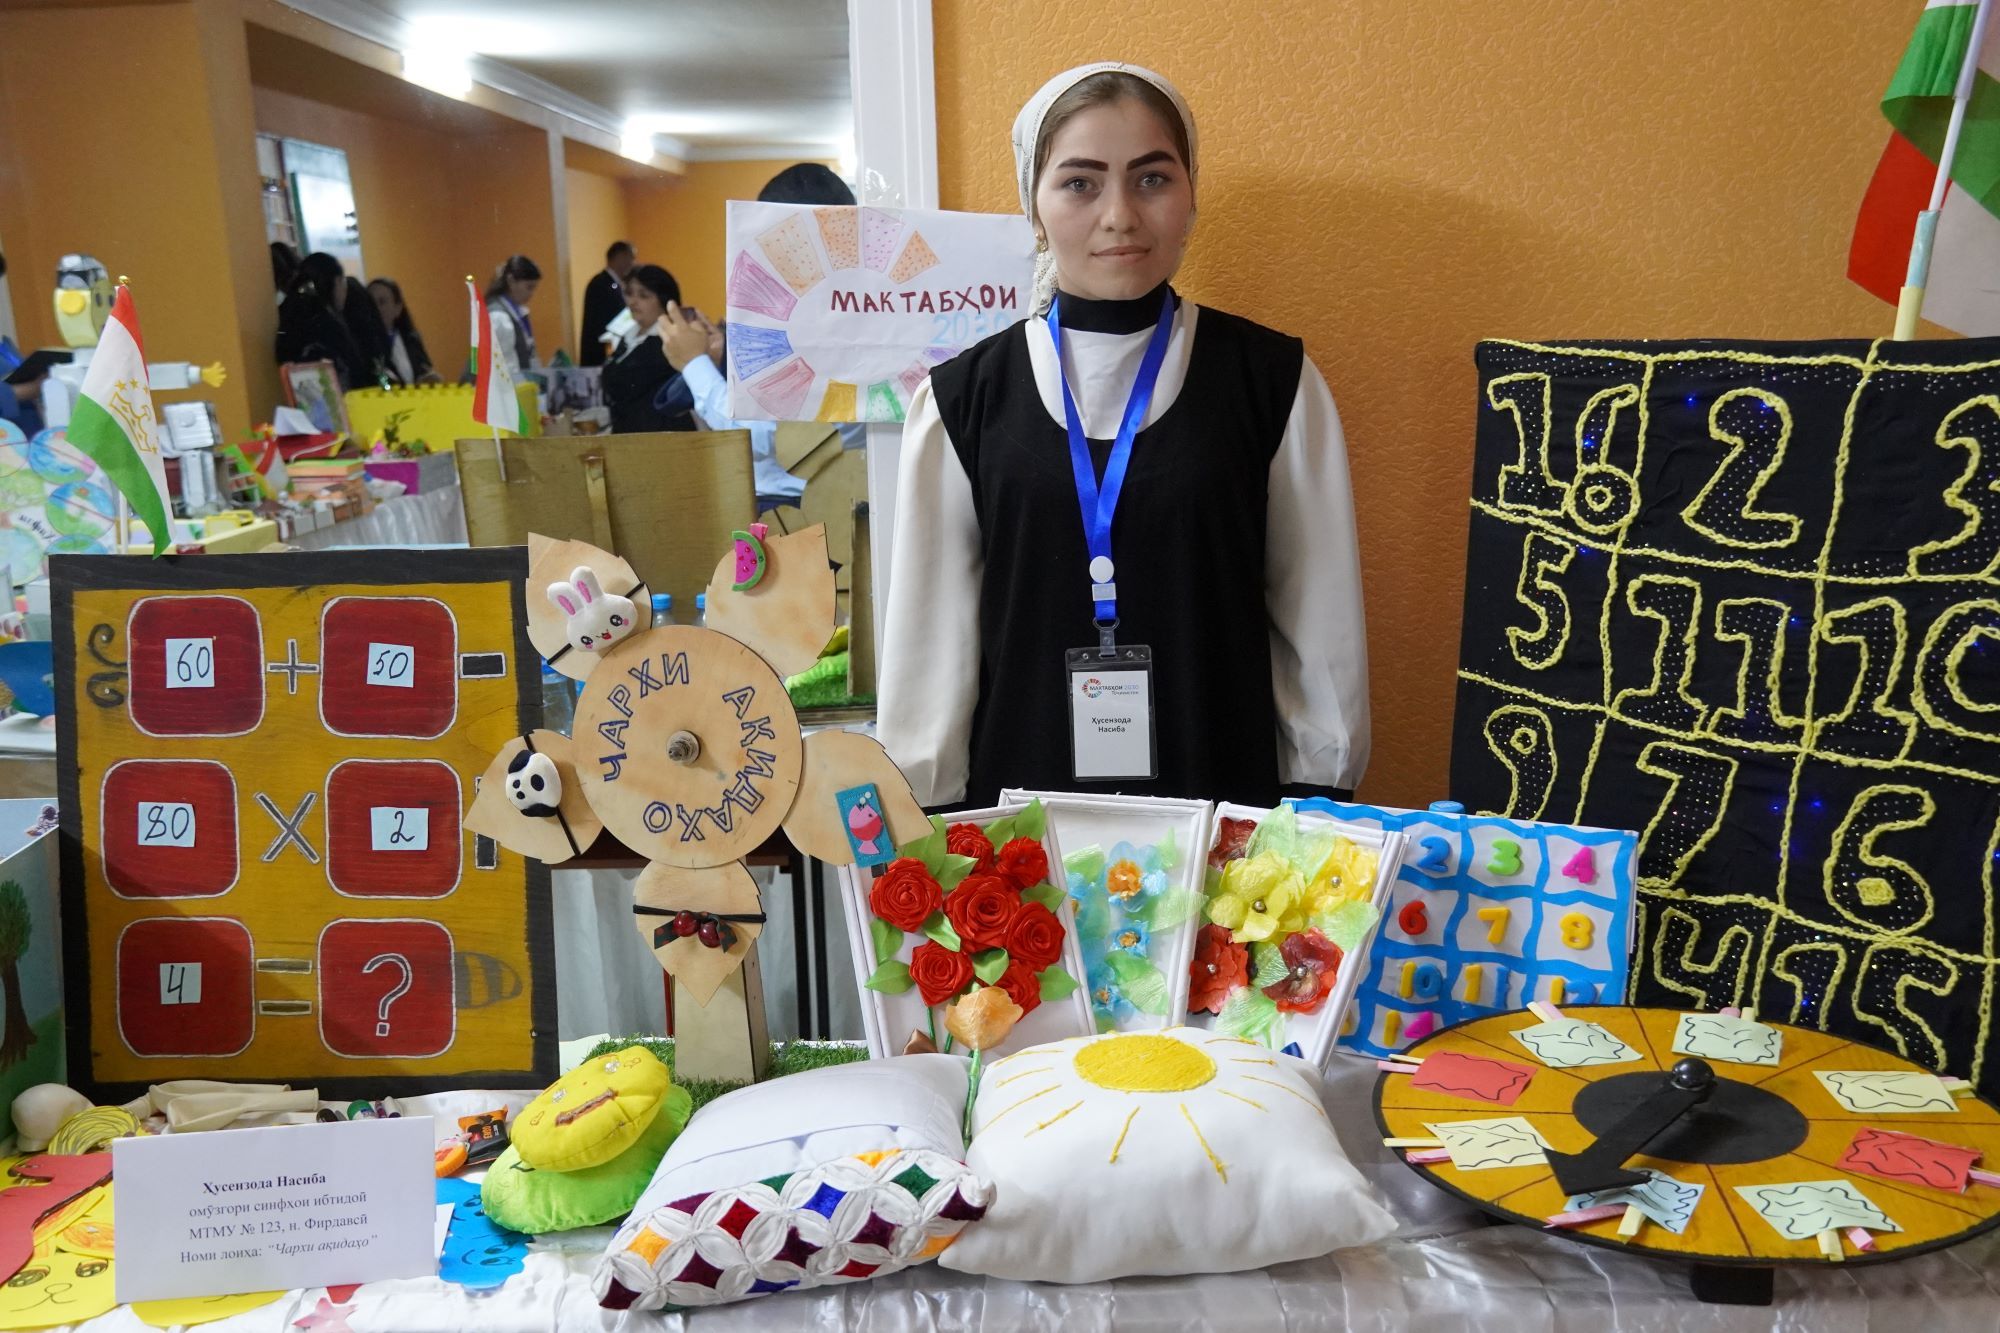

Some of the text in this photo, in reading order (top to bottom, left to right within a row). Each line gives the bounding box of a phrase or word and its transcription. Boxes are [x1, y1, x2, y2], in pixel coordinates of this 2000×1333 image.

[1680, 386, 1803, 550] 2
[1505, 531, 1577, 671] 5
[177, 643, 211, 681] 60
[373, 648, 408, 679] 50
[598, 651, 689, 782] ЧАРХИ
[147, 805, 190, 839] 80
[390, 810, 416, 843] 2
[1635, 741, 1739, 888] 7
[1824, 784, 1937, 936] 6
[1417, 836, 1597, 884] 2 3 4
[1400, 900, 1594, 950] 6 7 8
[167, 966, 185, 1003] 4
[1400, 961, 1443, 999] 10
[202, 1172, 327, 1196] Ҳусензода Насиба
[189, 1204, 250, 1220] омӯзгори
[314, 1192, 367, 1208] ибтидоӣ
[189, 1225, 236, 1240] МТМУ
[260, 1221, 284, 1236] 123,
[305, 1214, 368, 1231] Фирдавсӣ
[180, 1250, 216, 1264] Номи
